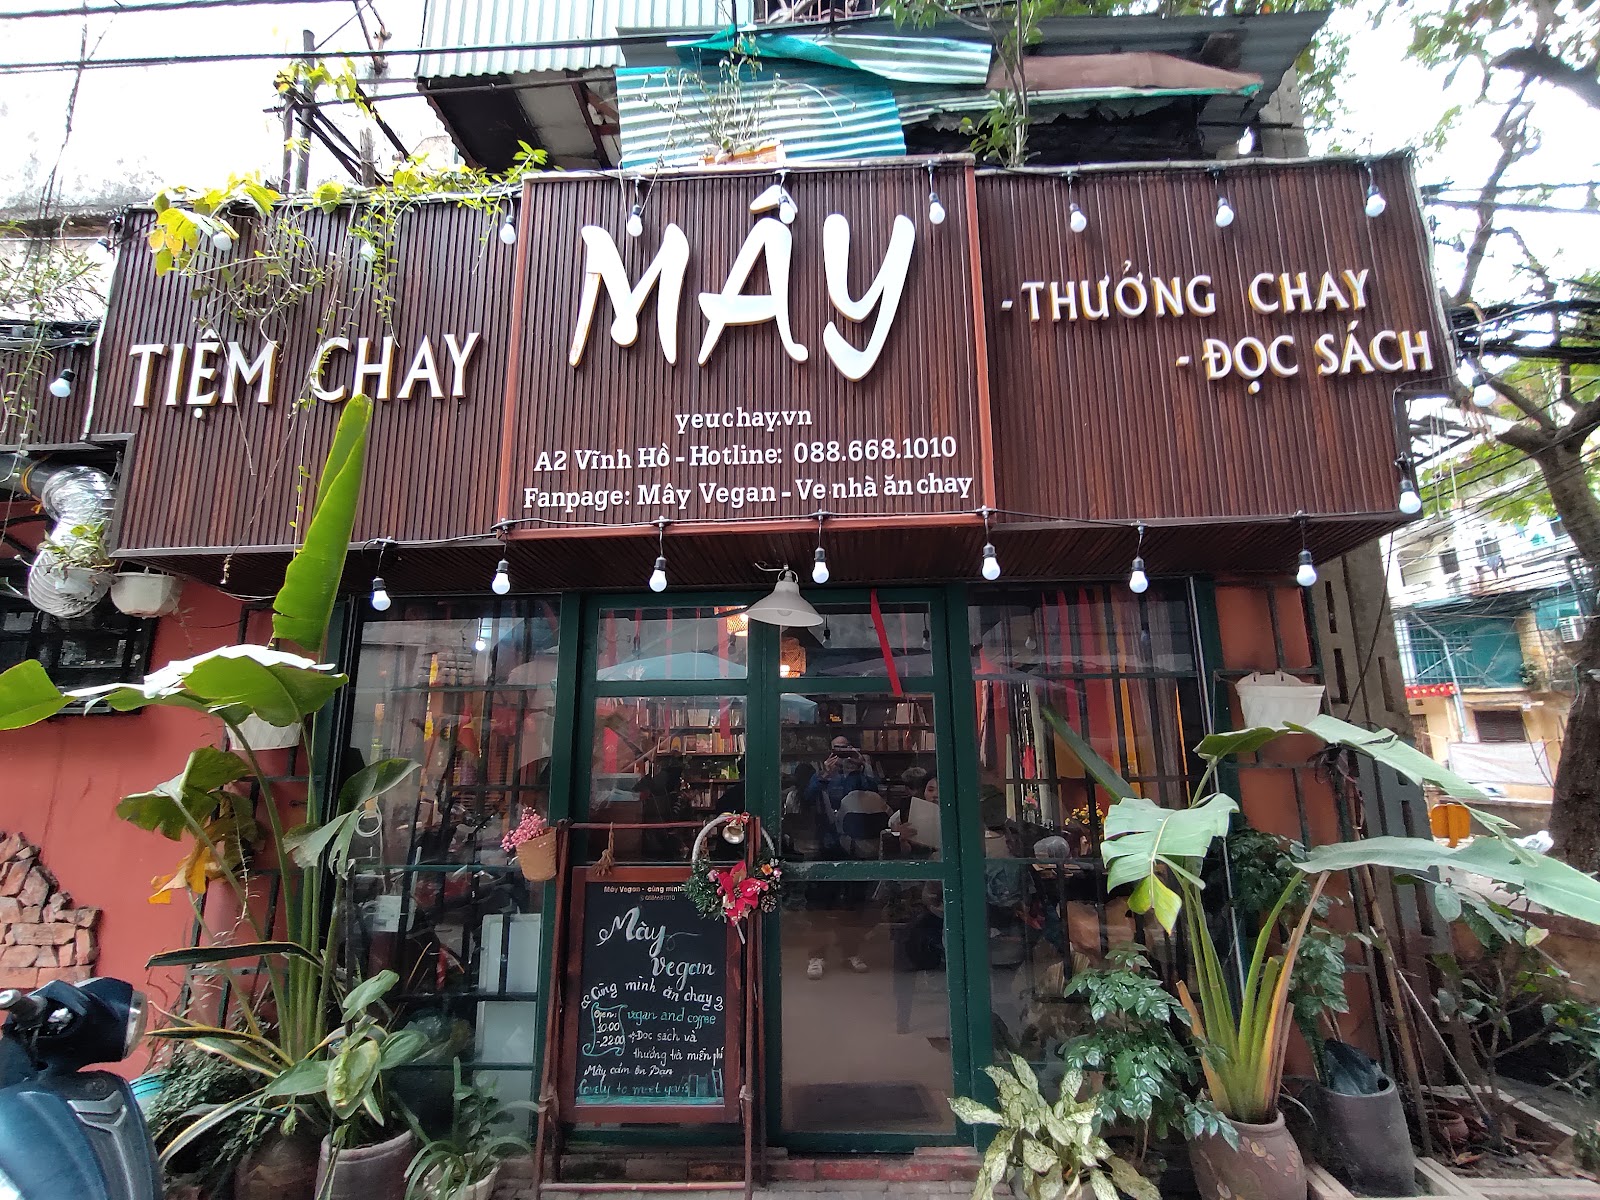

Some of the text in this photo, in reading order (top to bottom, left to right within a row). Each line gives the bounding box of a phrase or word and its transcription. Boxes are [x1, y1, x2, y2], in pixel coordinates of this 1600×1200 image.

[569, 184, 916, 383] MÂY
[1248, 268, 1370, 315] CHAY
[130, 329, 481, 419] TIỆM CHAY
[1202, 334, 1299, 395] ĐỌC
[1314, 320, 1434, 377] SÁCH
[675, 407, 813, 434] yeuchay.vn
[533, 451, 567, 472] A2
[575, 449, 632, 470] Vĩnh
[638, 442, 671, 468] Hồ
[689, 444, 783, 467] Hotline:
[793, 436, 957, 464] 088.668.1010
[524, 488, 630, 513] Fanpage:
[637, 484, 691, 509] Mây
[699, 484, 776, 508] Vegan
[831, 475, 879, 500] nhà
[884, 474, 913, 497] ăn
[917, 472, 973, 498] chay
[660, 1007, 685, 1022] and
[684, 986, 713, 1010] chay
[684, 1030, 698, 1043] và
